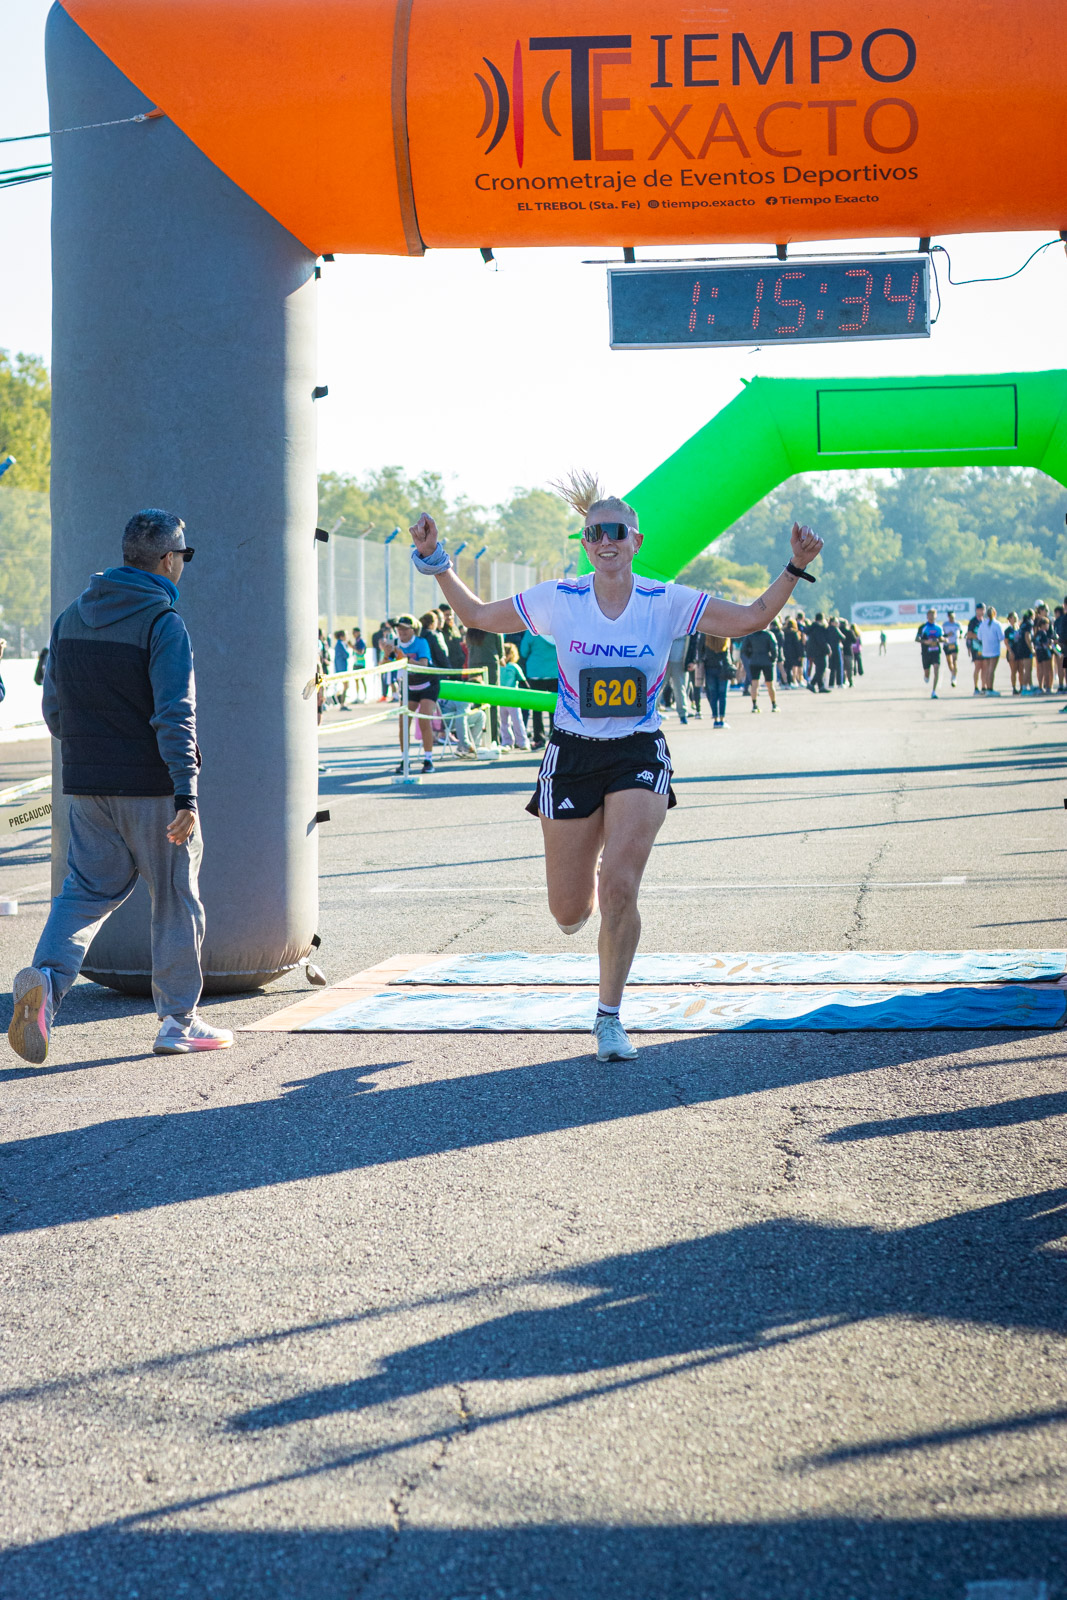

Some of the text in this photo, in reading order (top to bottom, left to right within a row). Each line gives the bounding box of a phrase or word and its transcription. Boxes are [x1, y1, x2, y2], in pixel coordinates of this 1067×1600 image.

[474, 164, 919, 193] Cronometraje de Eventos Deportivos
[517, 200, 641, 211] EL TREBOL (Sta. Fe)
[661, 198, 756, 211] tiempo.exacto
[779, 194, 880, 207] Tiempo Exacto
[688, 268, 920, 333] 1:15:34
[569, 640, 655, 658] RUNNEA
[593, 678, 637, 707] 620
